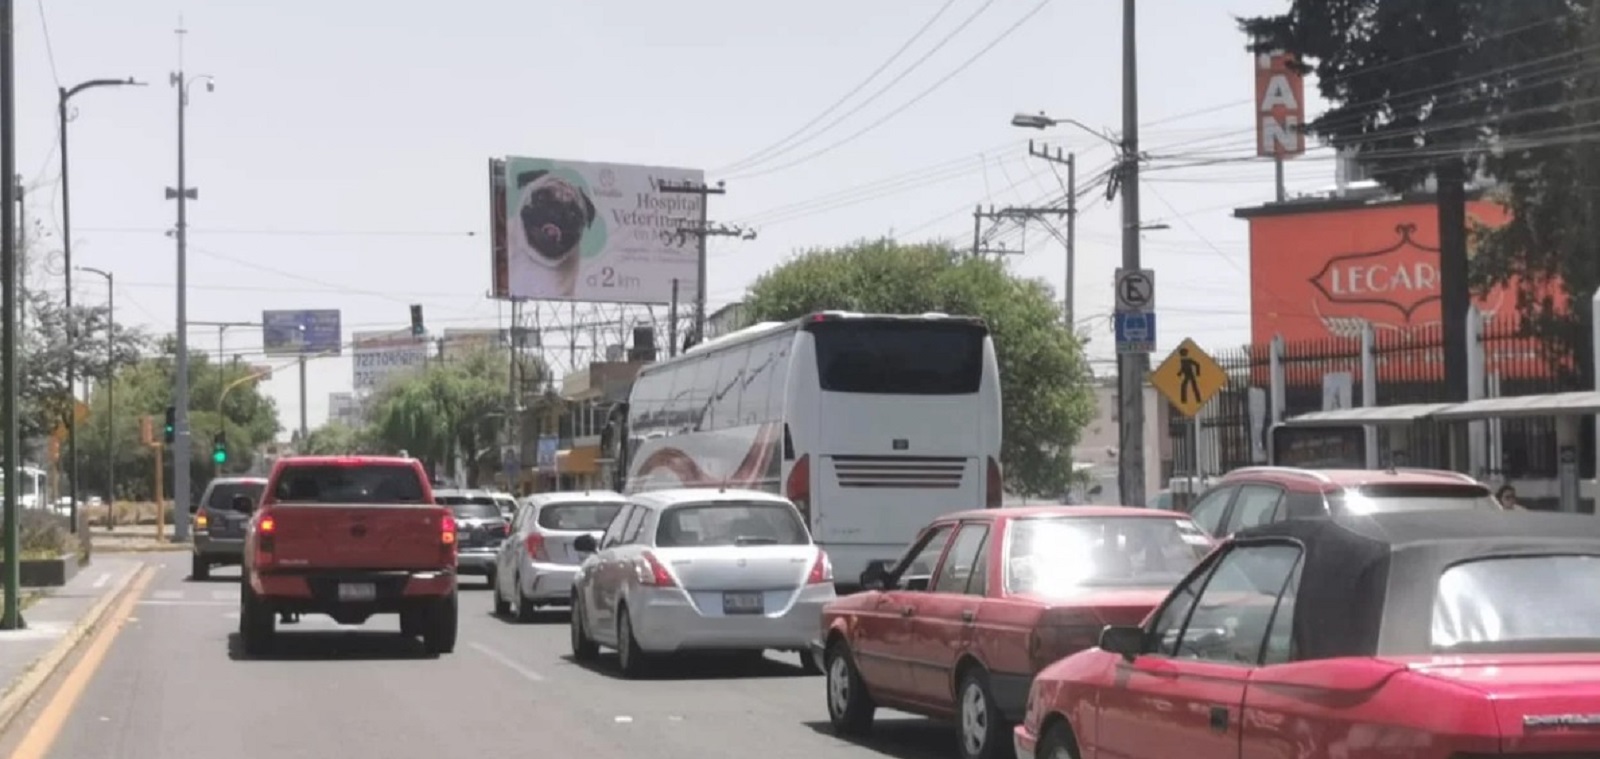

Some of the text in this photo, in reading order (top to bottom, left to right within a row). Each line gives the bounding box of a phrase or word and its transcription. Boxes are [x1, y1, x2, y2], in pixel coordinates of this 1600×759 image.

[636, 193, 701, 216] Hospital
[602, 267, 615, 288] 2
[618, 275, 641, 289] km
[1331, 262, 1442, 295] LECAR
